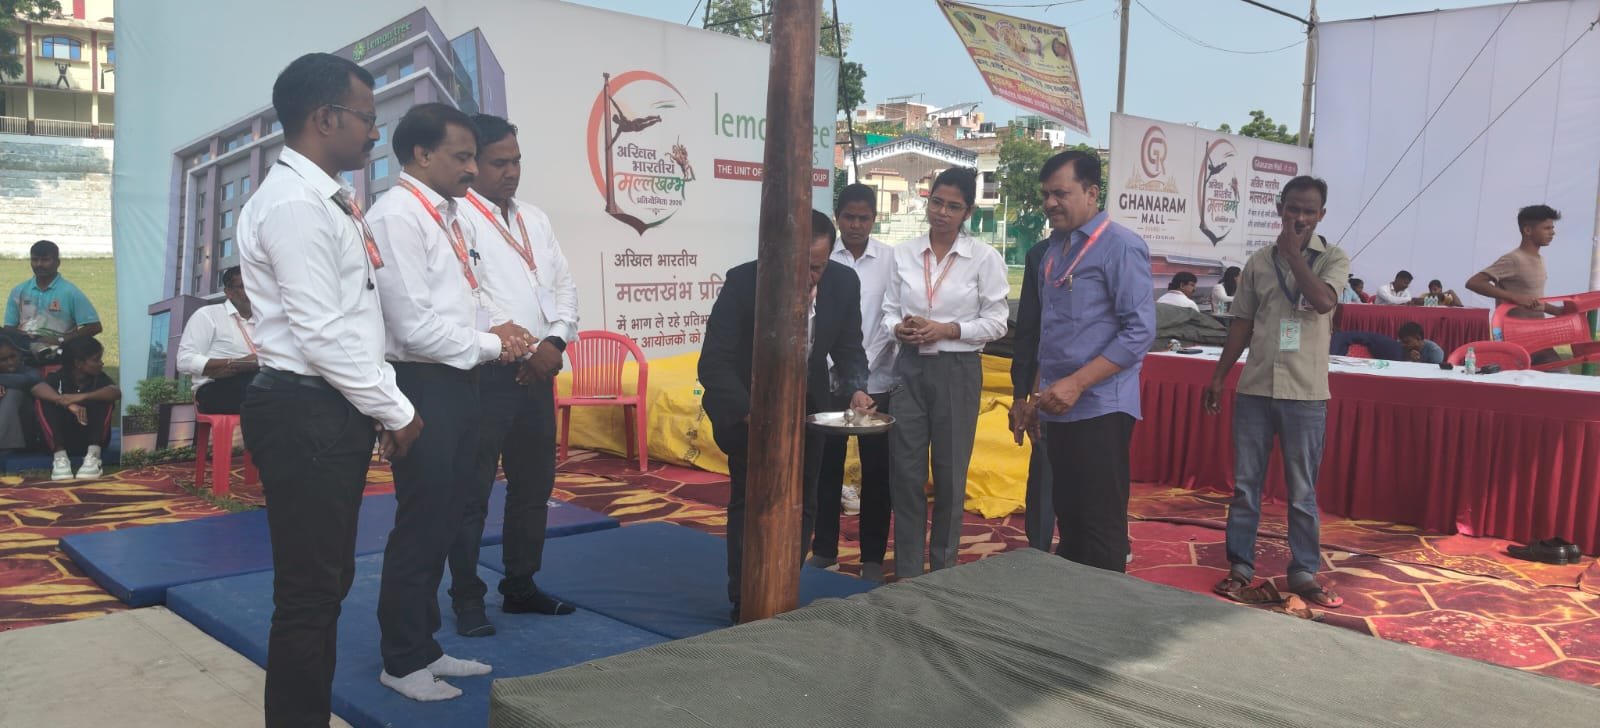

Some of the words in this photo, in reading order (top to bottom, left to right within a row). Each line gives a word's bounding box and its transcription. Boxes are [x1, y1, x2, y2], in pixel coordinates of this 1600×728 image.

[616, 143, 656, 160] अखिल
[632, 159, 675, 174] भारतीय
[717, 164, 732, 174] THE
[734, 166, 750, 176] UNIT
[812, 173, 828, 182] OUP
[614, 172, 686, 204] मल्लखम्भ
[1119, 193, 1186, 214] GHANARAM
[1141, 214, 1165, 224] MALL
[614, 248, 652, 268] अखिल
[657, 249, 698, 267] भारतीय
[614, 275, 694, 302] मल्लखंभ
[616, 314, 626, 331] में
[631, 318, 652, 330] भाग
[654, 312, 664, 329] ले
[667, 312, 680, 328] रहे
[641, 330, 686, 348] आयोजकों
[688, 328, 701, 344] को
